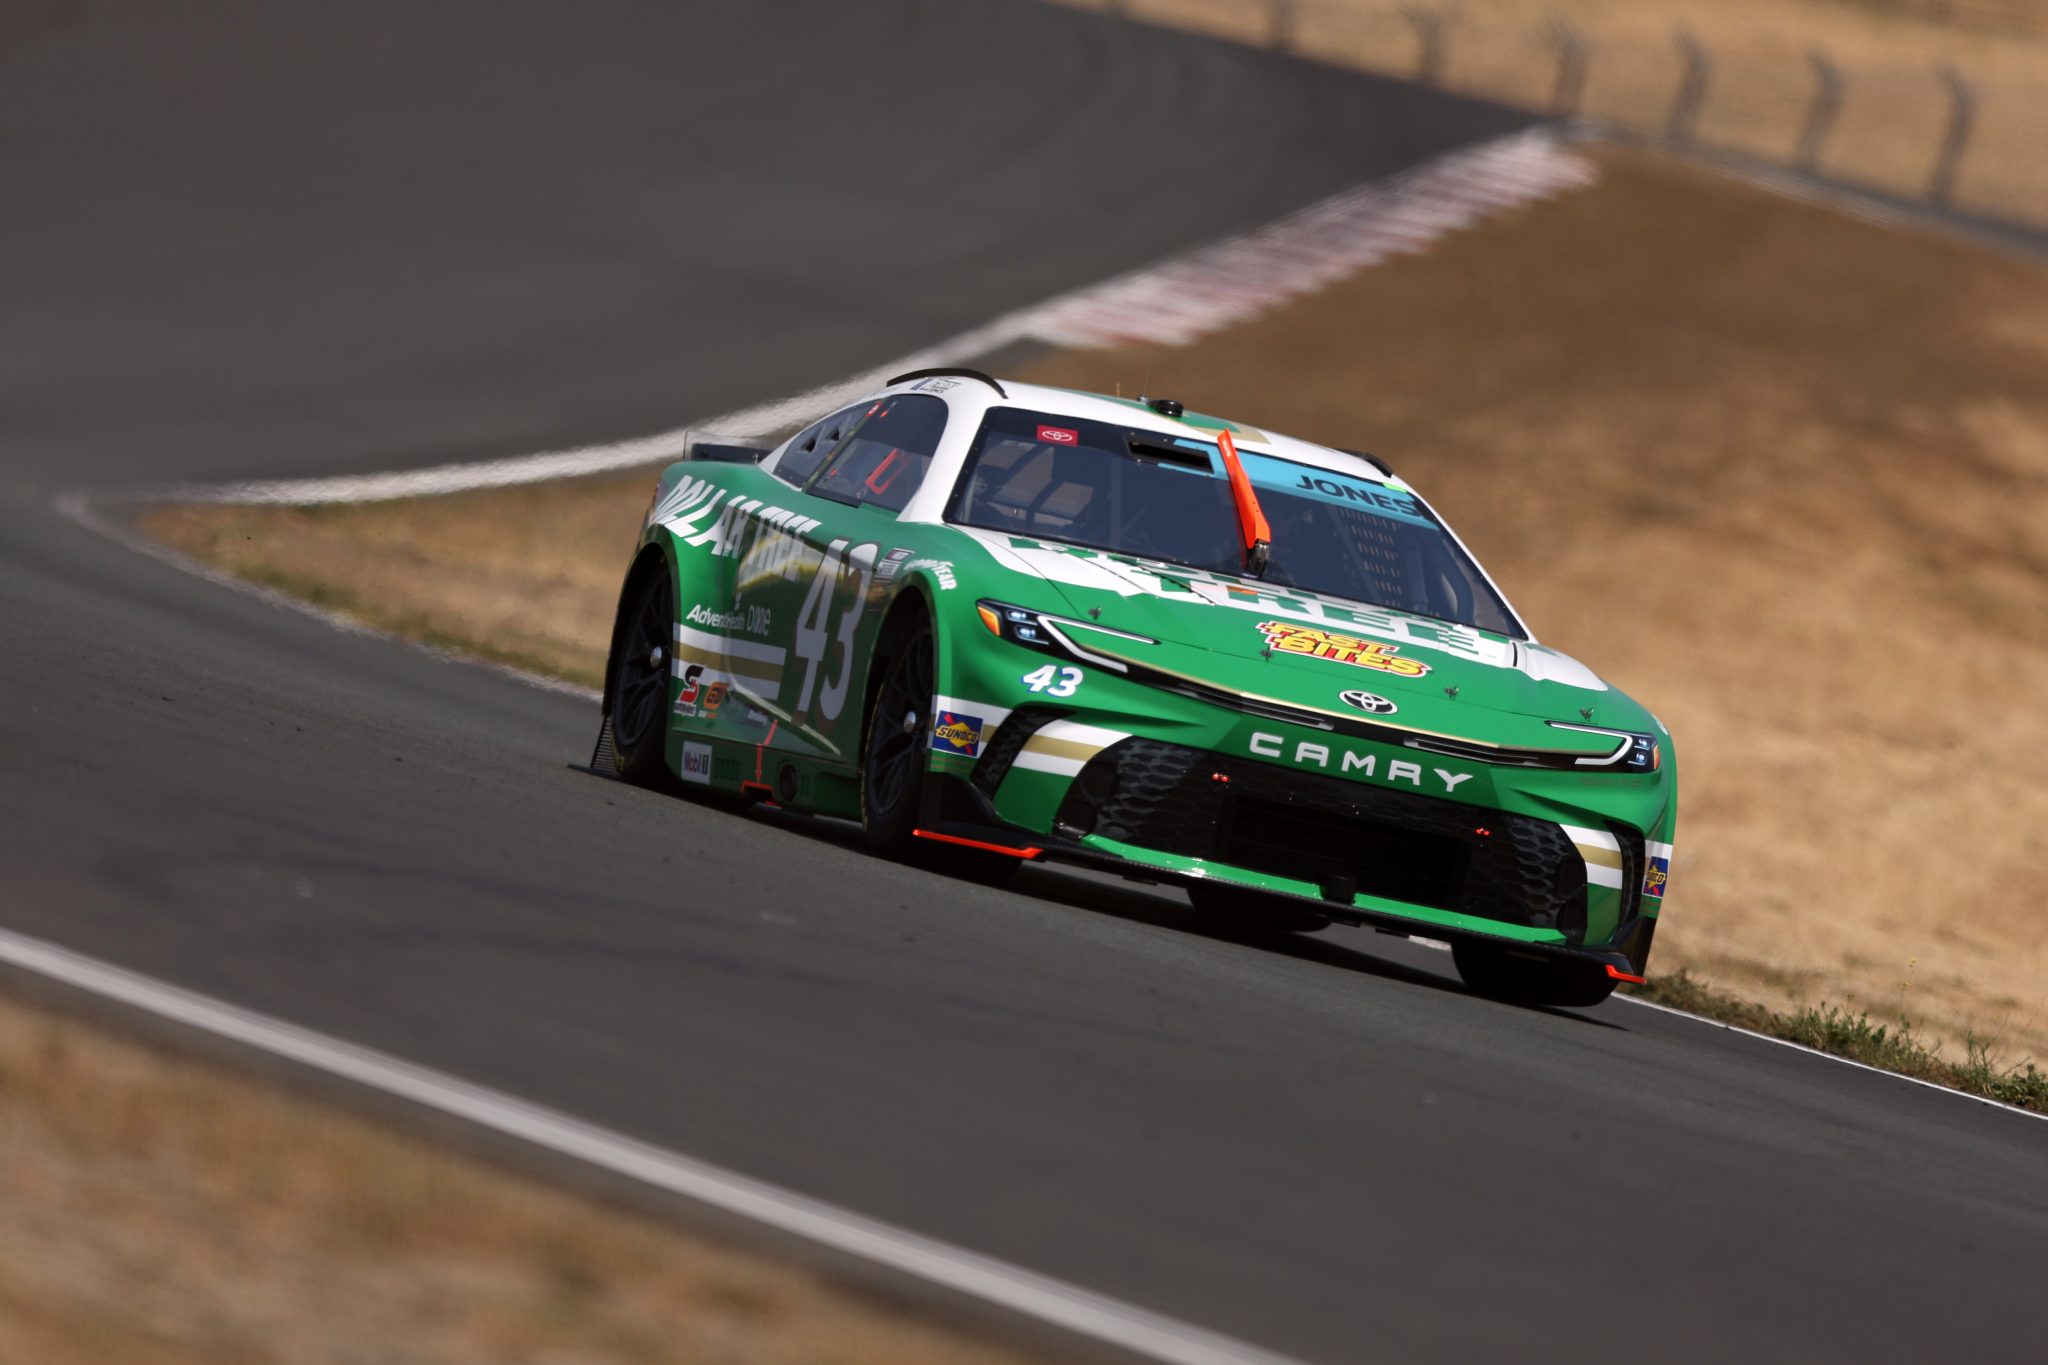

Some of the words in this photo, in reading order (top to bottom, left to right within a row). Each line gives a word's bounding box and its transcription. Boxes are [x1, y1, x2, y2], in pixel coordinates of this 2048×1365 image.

[1296, 475, 1422, 517] JONES
[795, 539, 878, 720] 43
[1265, 623, 1392, 653] FAST
[1274, 636, 1425, 675] BITES
[1022, 664, 1083, 696] 43
[937, 727, 978, 743] SUNOCO
[1249, 731, 1474, 793] CAMRY
